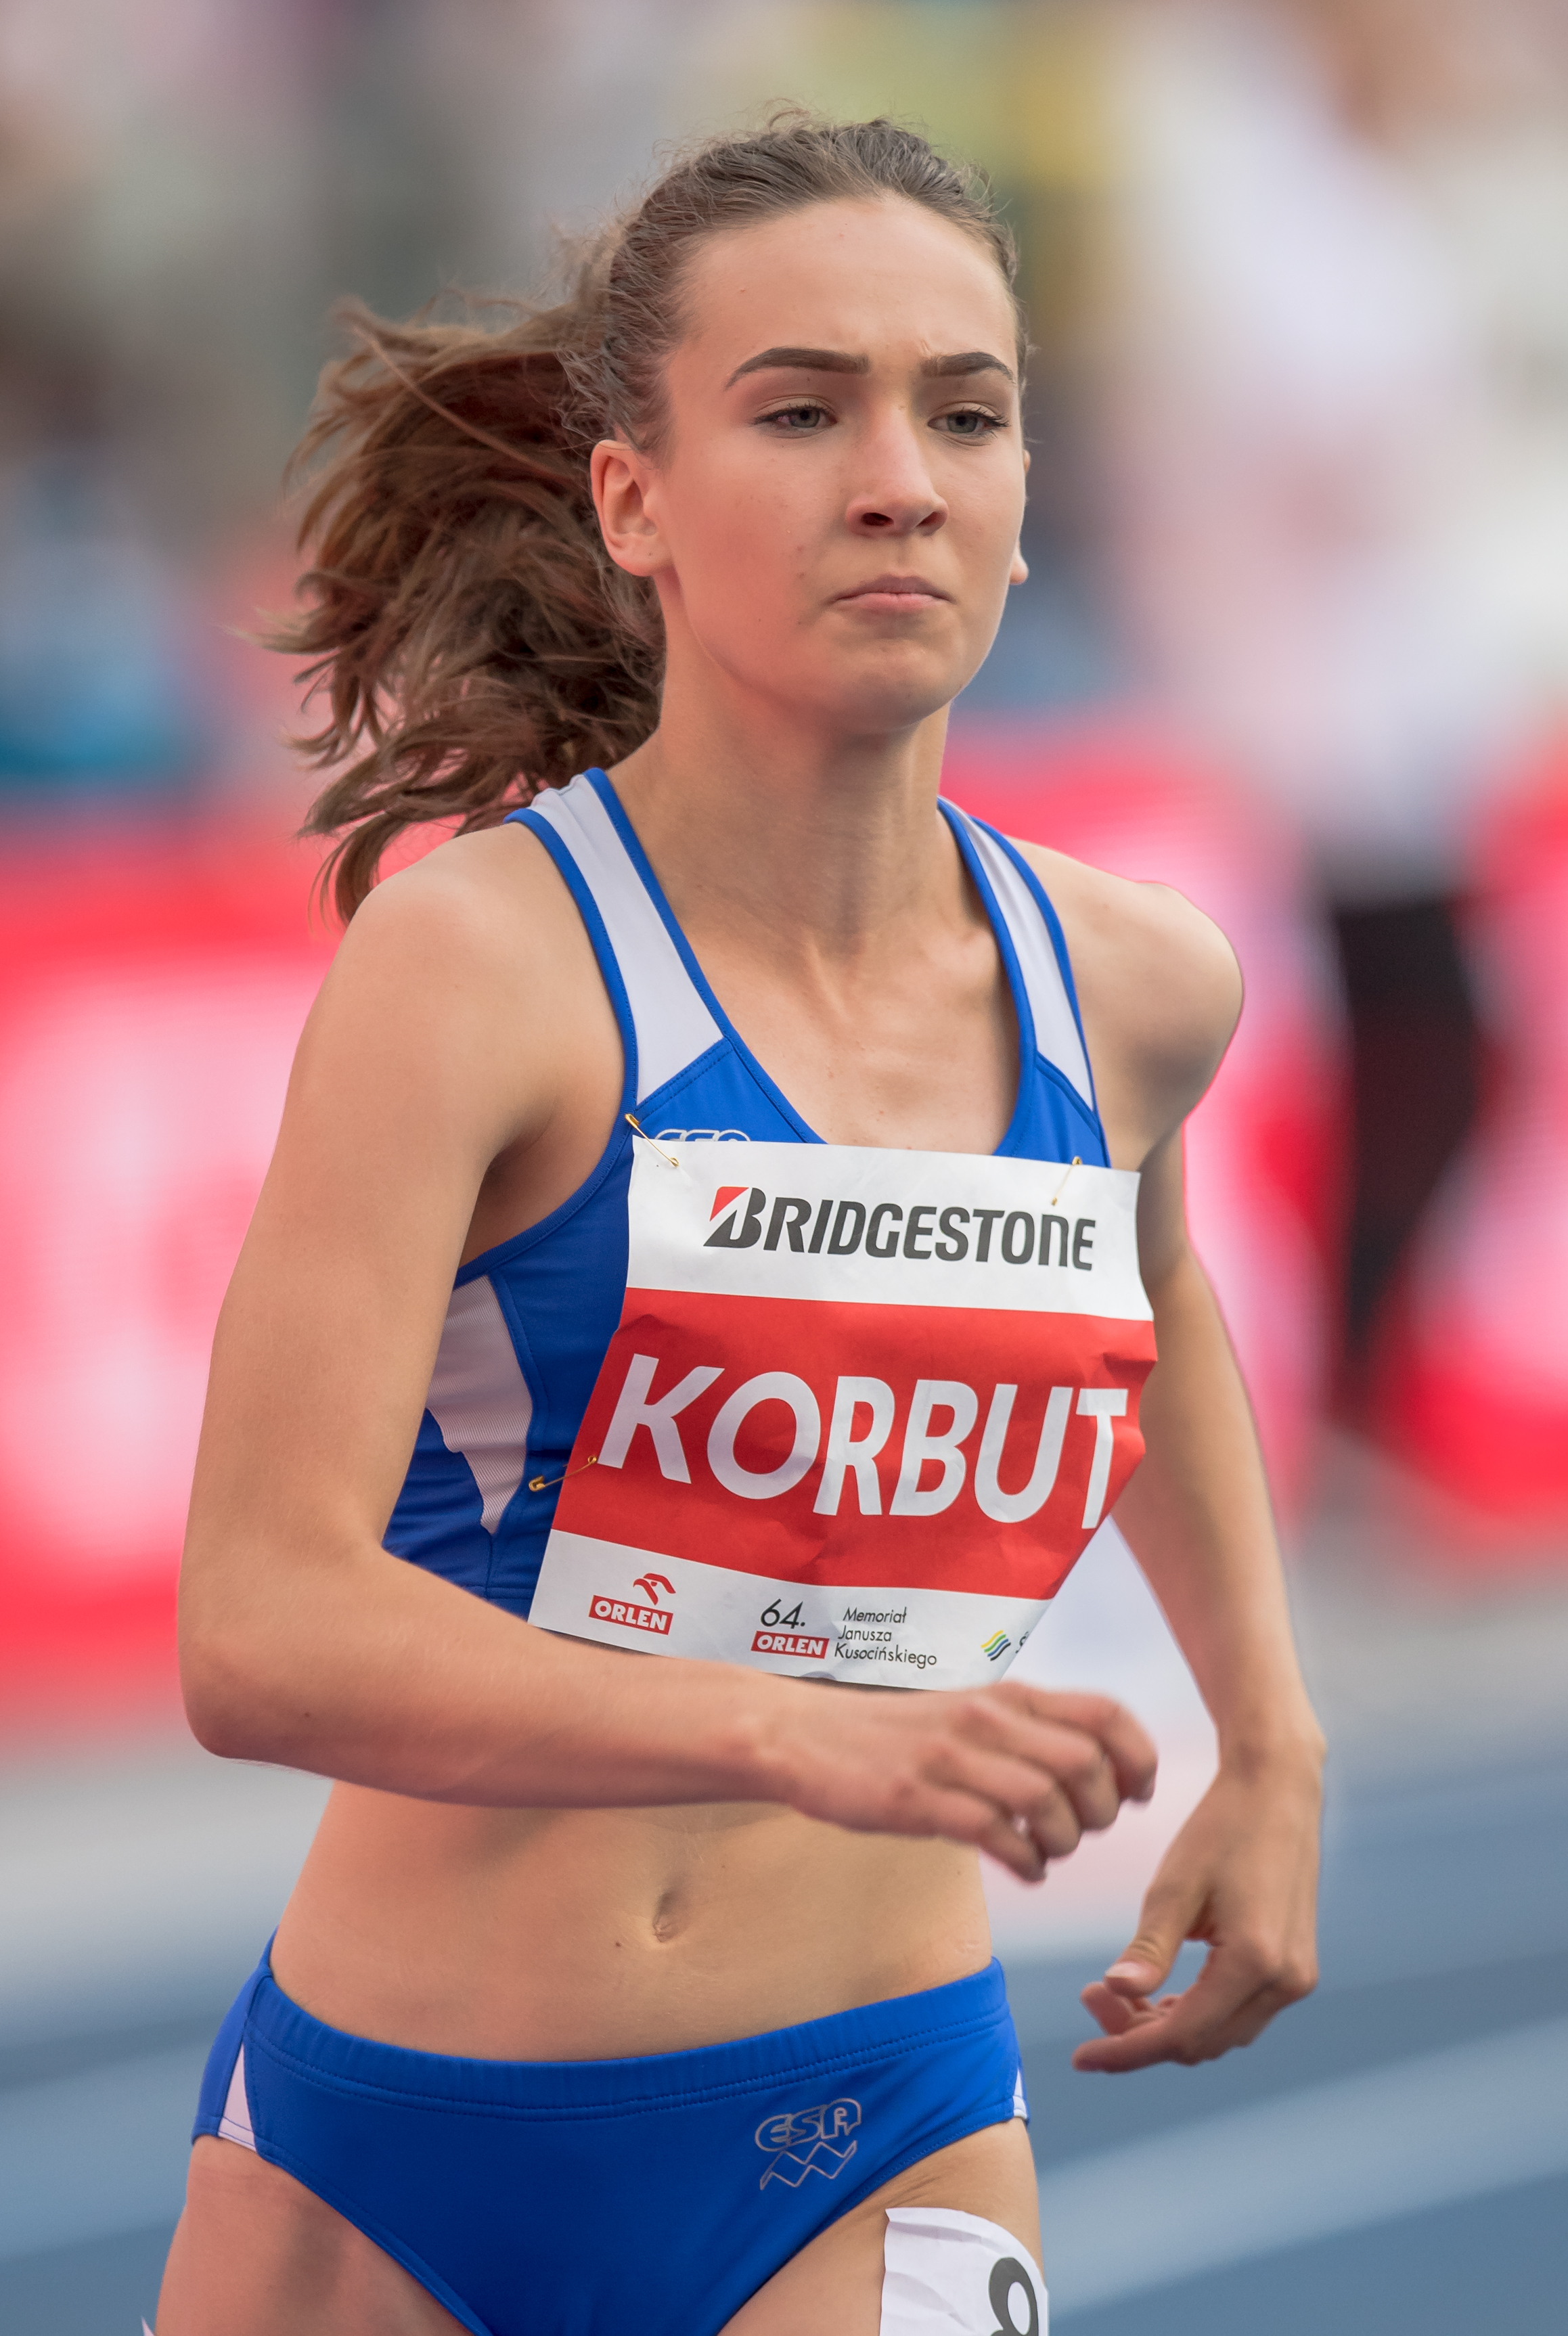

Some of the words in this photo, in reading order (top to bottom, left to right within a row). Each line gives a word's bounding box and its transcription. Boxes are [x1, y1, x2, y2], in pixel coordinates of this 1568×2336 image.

[703, 1186, 1096, 1271] BRIDGESTONE
[598, 1353, 1128, 1529] KORBUT
[593, 1600, 667, 1631] ORLEN
[760, 1598, 806, 1629] 64.
[843, 1607, 907, 1623] Memoriał
[756, 1634, 825, 1657] ORLEN
[838, 1625, 892, 1642] Janusza
[834, 1643, 937, 1669] Kusocińskiego
